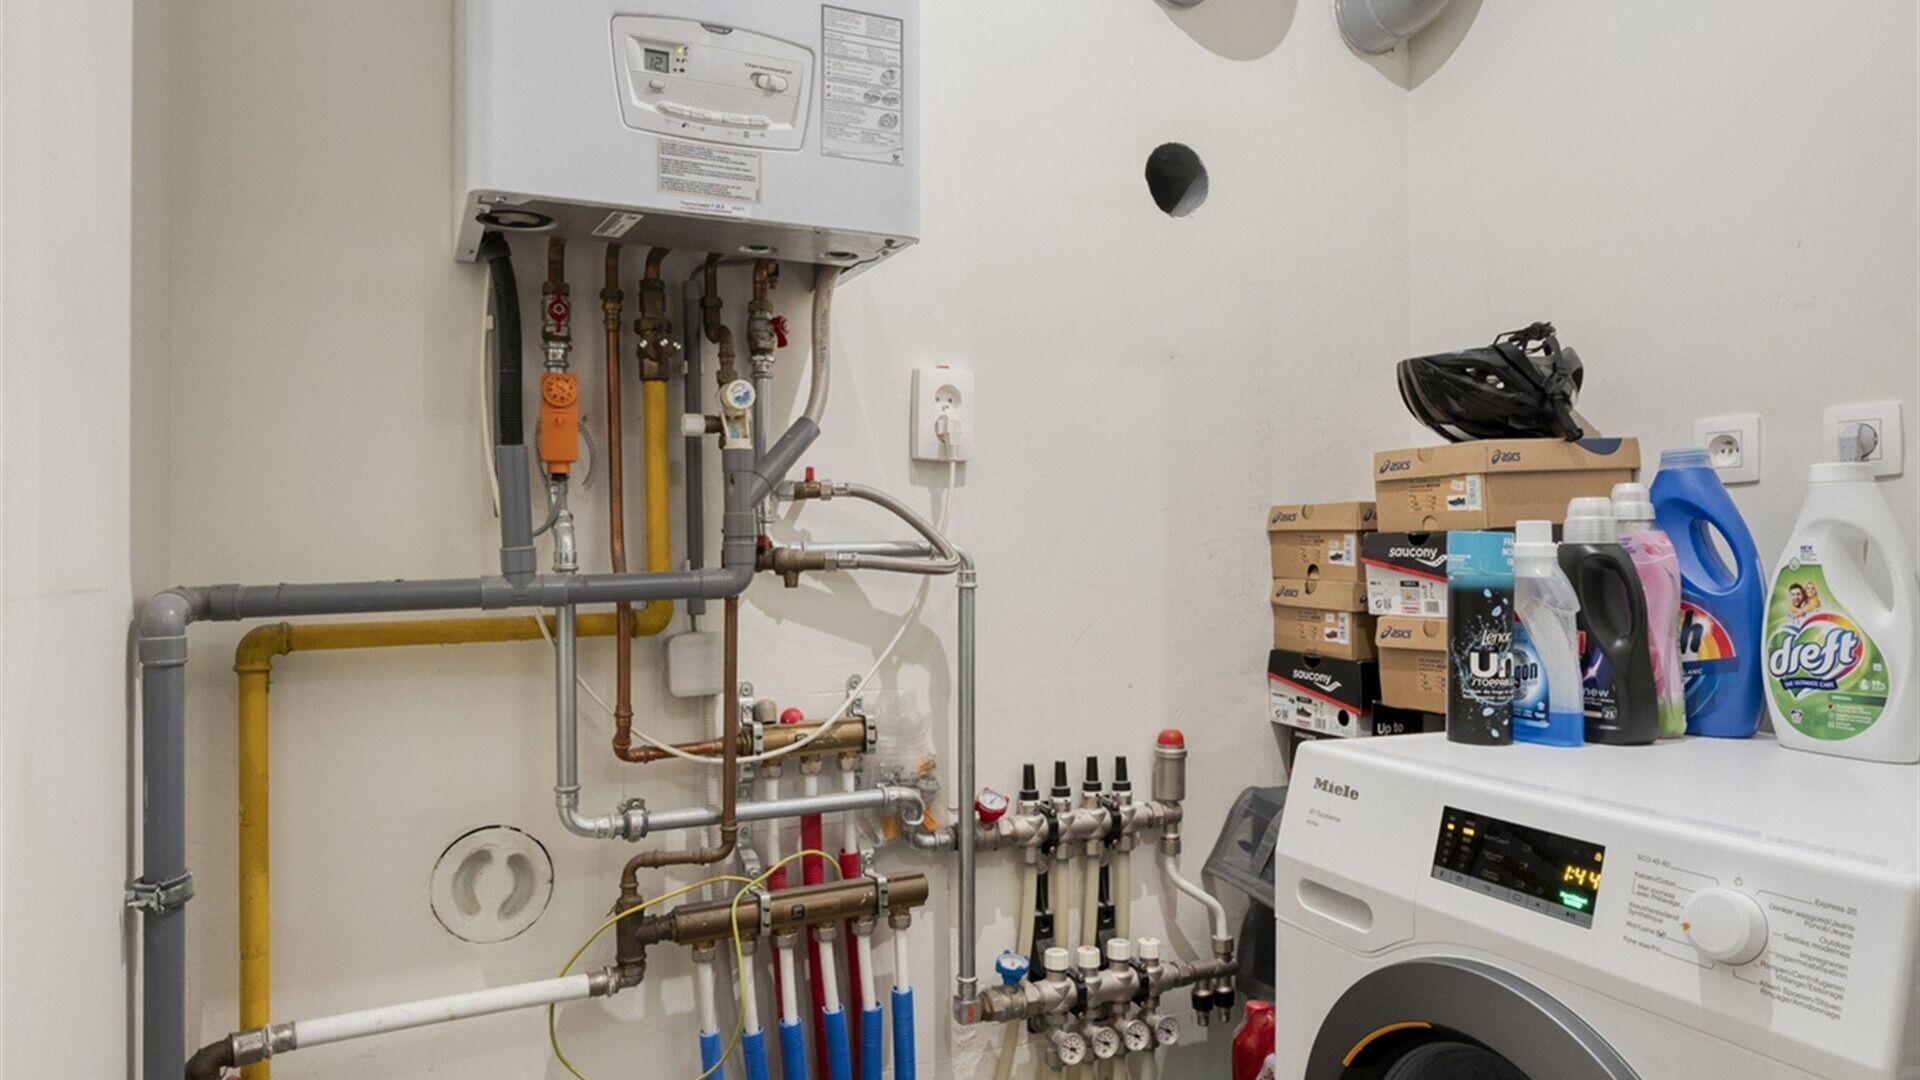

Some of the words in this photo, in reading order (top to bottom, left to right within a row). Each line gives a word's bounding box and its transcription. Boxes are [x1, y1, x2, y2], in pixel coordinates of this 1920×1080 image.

[650, 56, 663, 71] 12
[1388, 547, 1438, 560] saucony
[1770, 629, 1858, 677] dreft
[1292, 669, 1332, 686] saucony
[1514, 662, 1538, 688] gon
[1583, 687, 1610, 698] new
[1377, 722, 1392, 736] Up
[1393, 722, 1404, 732] to
[1313, 776, 1359, 800] Miele
[1637, 854, 1652, 863] ECO
[1563, 865, 1601, 890] 1:44
[1814, 898, 1845, 913] Express
[1846, 906, 1858, 916] 20
[1783, 933, 1810, 948] Textiles
[1811, 942, 1851, 959] modernes
[1818, 936, 1852, 950] Outdoor
